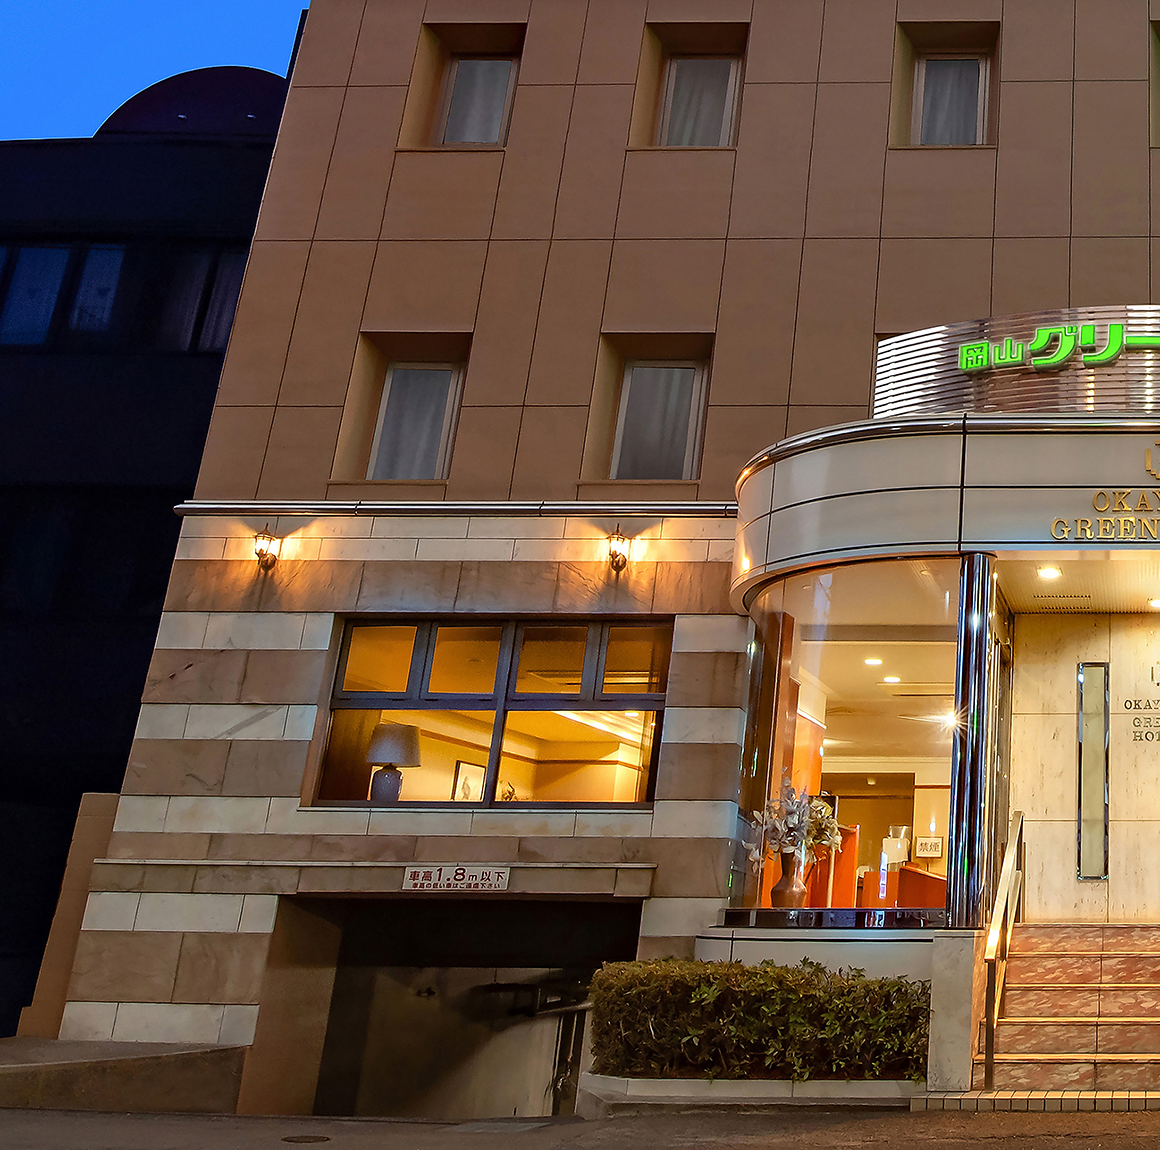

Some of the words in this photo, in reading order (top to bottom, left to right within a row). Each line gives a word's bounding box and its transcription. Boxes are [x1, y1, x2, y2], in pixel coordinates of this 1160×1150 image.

[1050, 517, 1160, 541] GREEN
[408, 867, 506, 882] 車高1.8m以下
